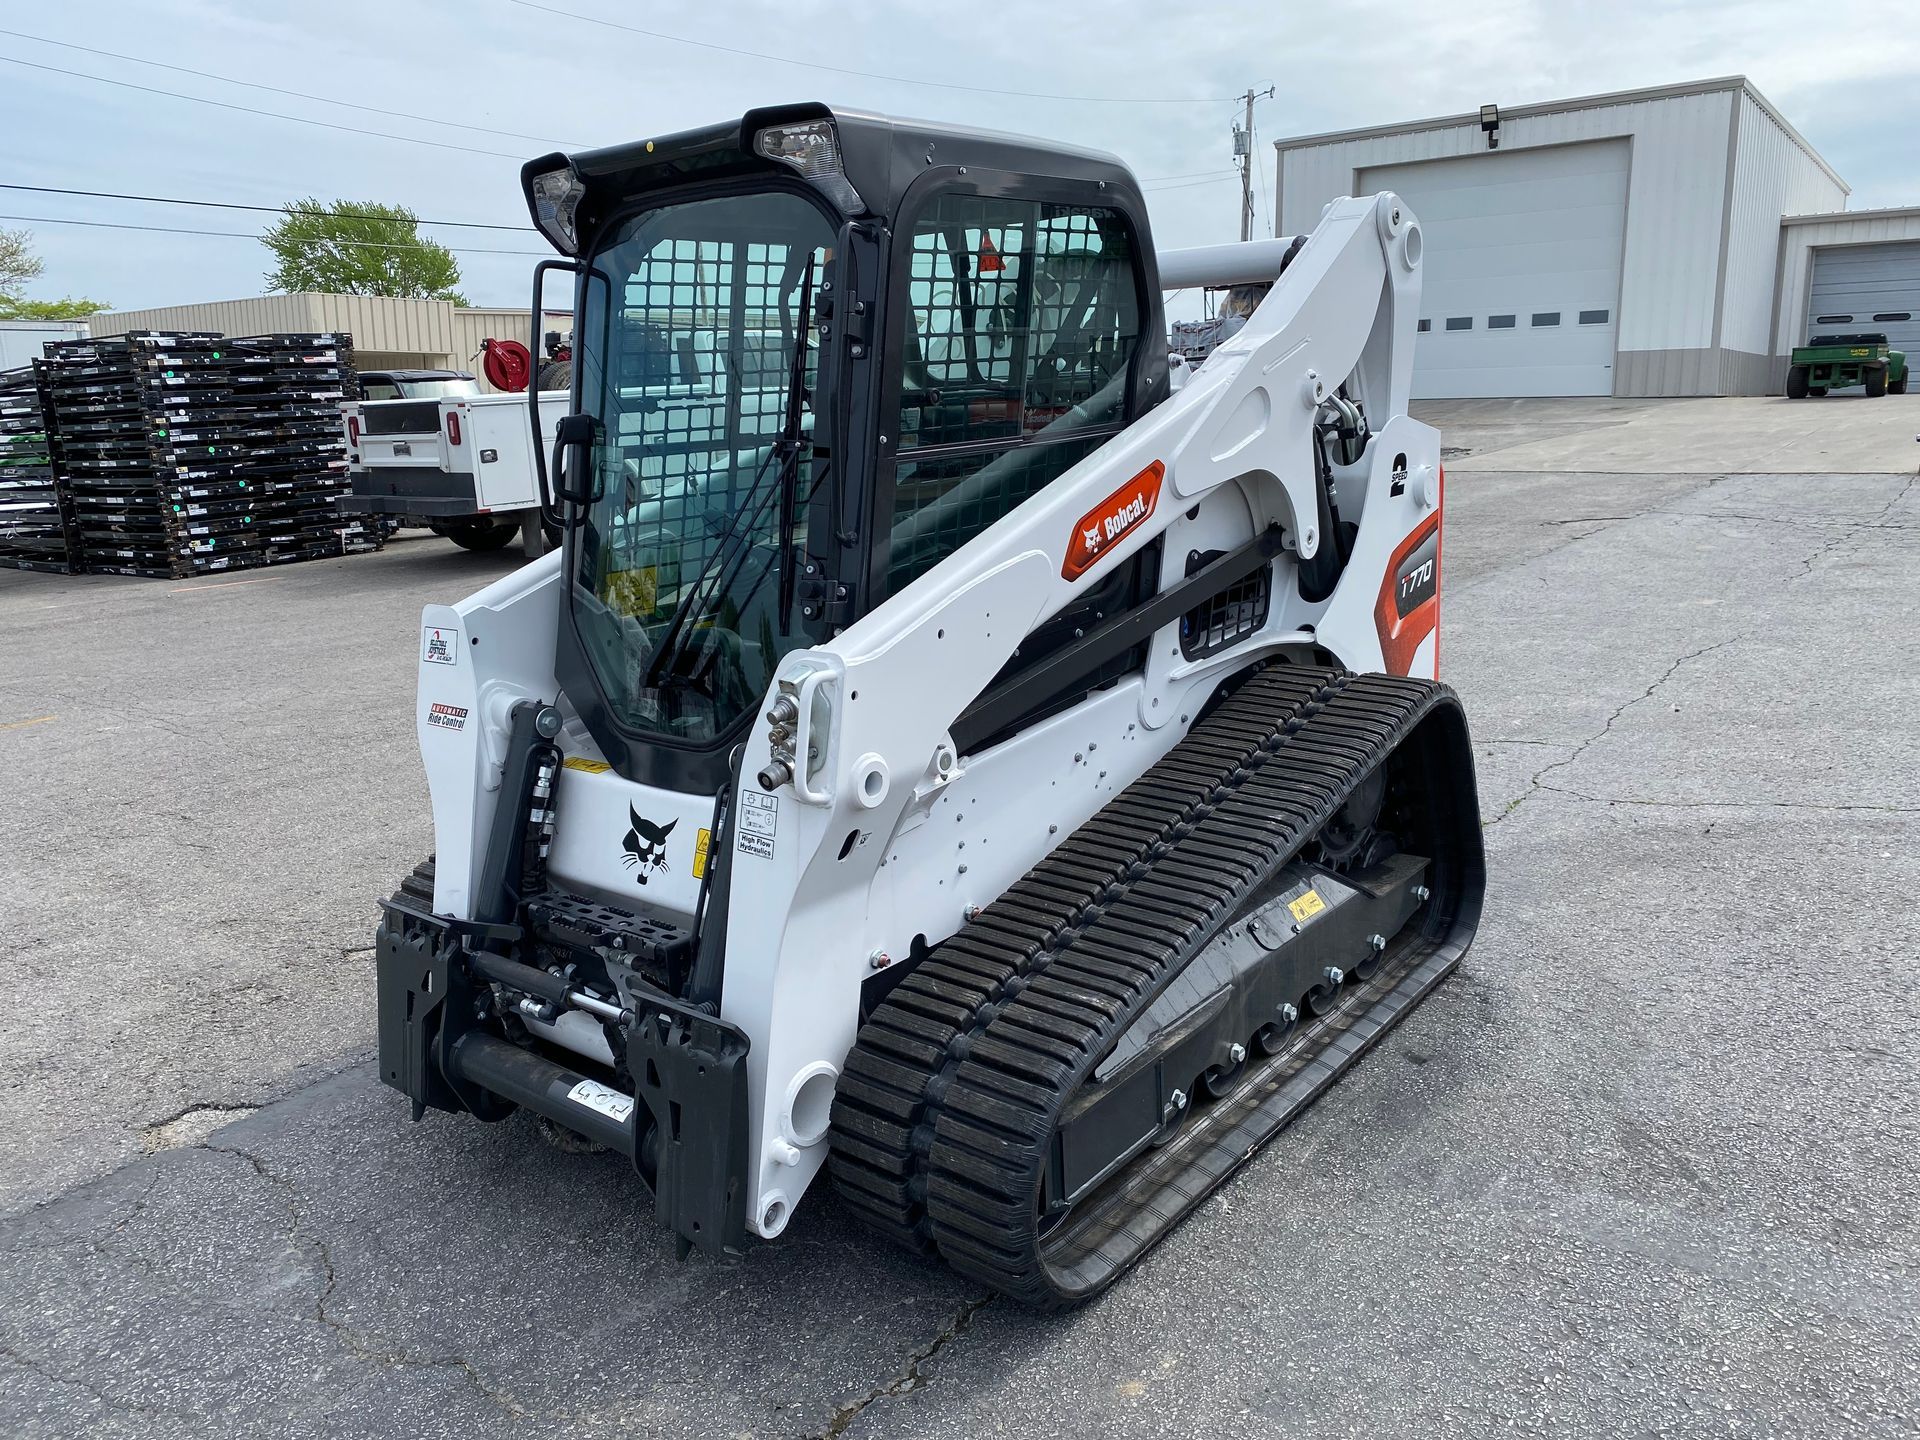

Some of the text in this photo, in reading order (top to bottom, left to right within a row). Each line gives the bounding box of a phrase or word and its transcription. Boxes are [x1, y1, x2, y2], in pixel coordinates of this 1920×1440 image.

[1392, 470, 1408, 482] SPEED
[1104, 491, 1145, 541] Bobcat
[1401, 558, 1433, 599] T770
[432, 704, 467, 717] AUTOMATIC
[428, 713, 466, 729] Ride Control
[740, 841, 771, 856] Hydraulics
[742, 834, 771, 848] High Flow
